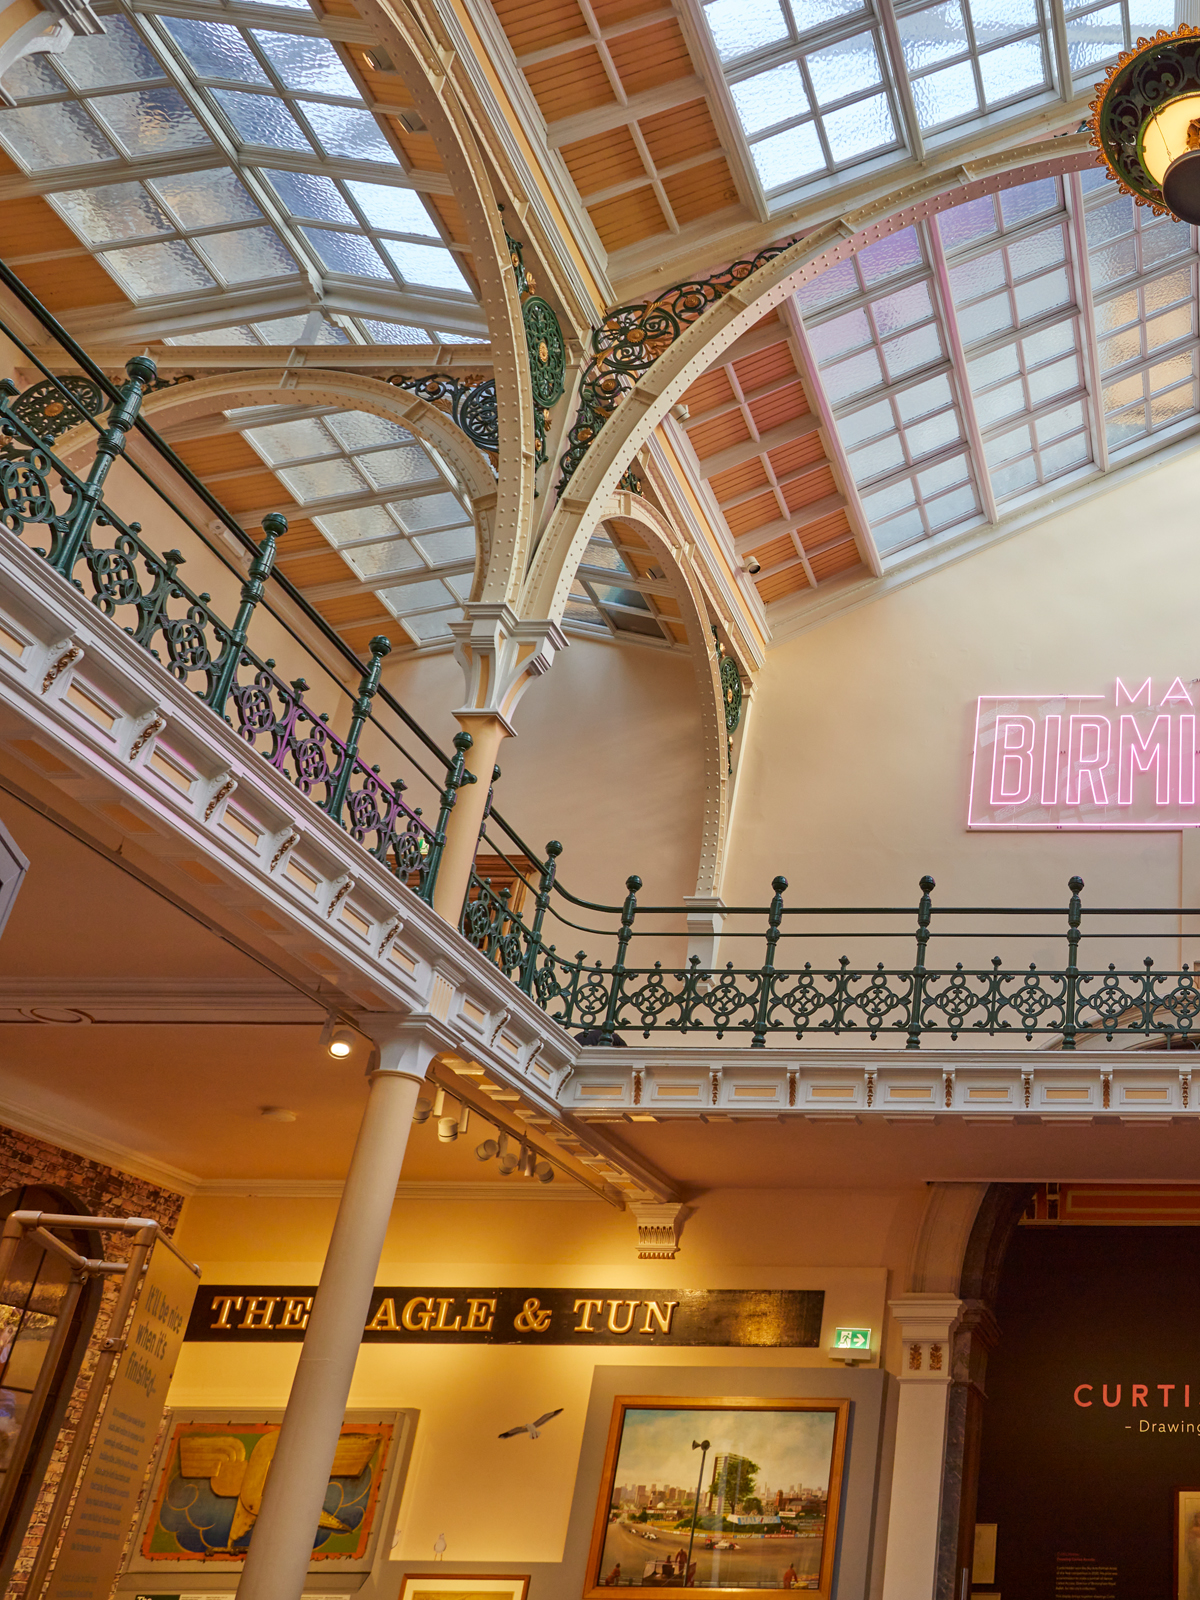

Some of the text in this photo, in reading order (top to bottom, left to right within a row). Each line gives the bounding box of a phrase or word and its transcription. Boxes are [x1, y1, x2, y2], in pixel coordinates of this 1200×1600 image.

[158, 1294, 170, 1324] be
[167, 1306, 184, 1335] nice
[210, 1295, 681, 1335] THE AGLE & TUN
[135, 1320, 157, 1354] when
